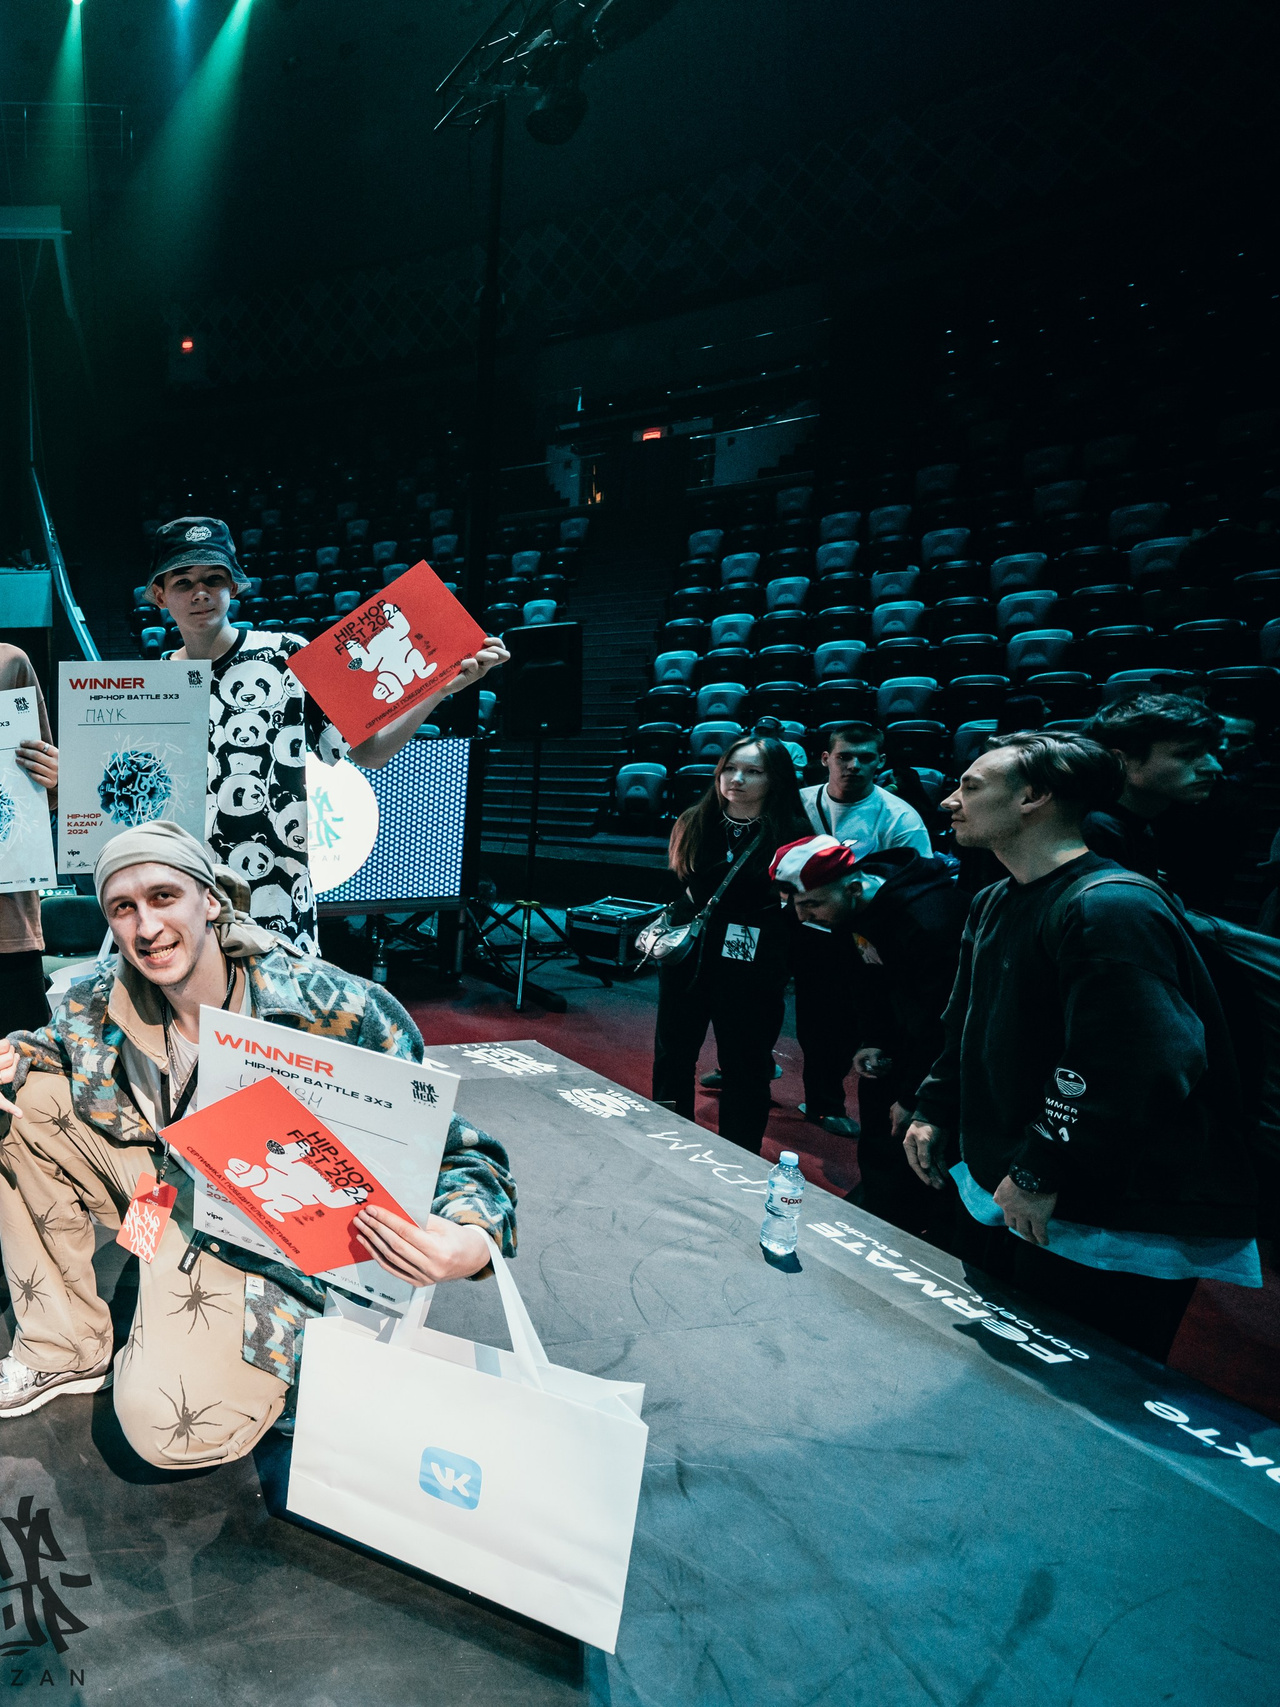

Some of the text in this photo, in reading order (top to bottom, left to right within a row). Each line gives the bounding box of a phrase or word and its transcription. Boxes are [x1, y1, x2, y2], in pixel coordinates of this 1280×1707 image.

[333, 599, 387, 643] HIP-HOP
[334, 604, 402, 656] FEST 2024
[69, 677, 145, 690] WINNER
[365, 702, 400, 730] СЕРТИФИКАТ
[400, 676, 439, 705] ПОБЕДИТЕЛЮ
[85, 708, 127, 723] ПАУК
[67, 849, 80, 857] vipe
[213, 1030, 335, 1078] WINNER
[244, 1058, 300, 1080] HIP-HOP
[303, 1076, 360, 1100] BATTLE
[363, 1094, 394, 1110] 3X3
[1045, 1096, 1078, 1115] MMER
[1045, 1108, 1078, 1124] RNEY
[286, 1129, 331, 1166] FEST
[324, 1167, 368, 1206] 2024
[299, 1152, 338, 1189] CERTIFICATE
[306, 1130, 375, 1195] HIP-HOP
[186, 1145, 226, 1184] СЕРТИФИКАТ
[224, 1180, 266, 1222] ПОБЕДИТЕЛЮ
[264, 1218, 301, 1255] ФЕСТИВАЛЯ
[206, 1211, 224, 1221] vipe
[780, 1196, 803, 1206] арх
[835, 1220, 1090, 1360] concept studio
